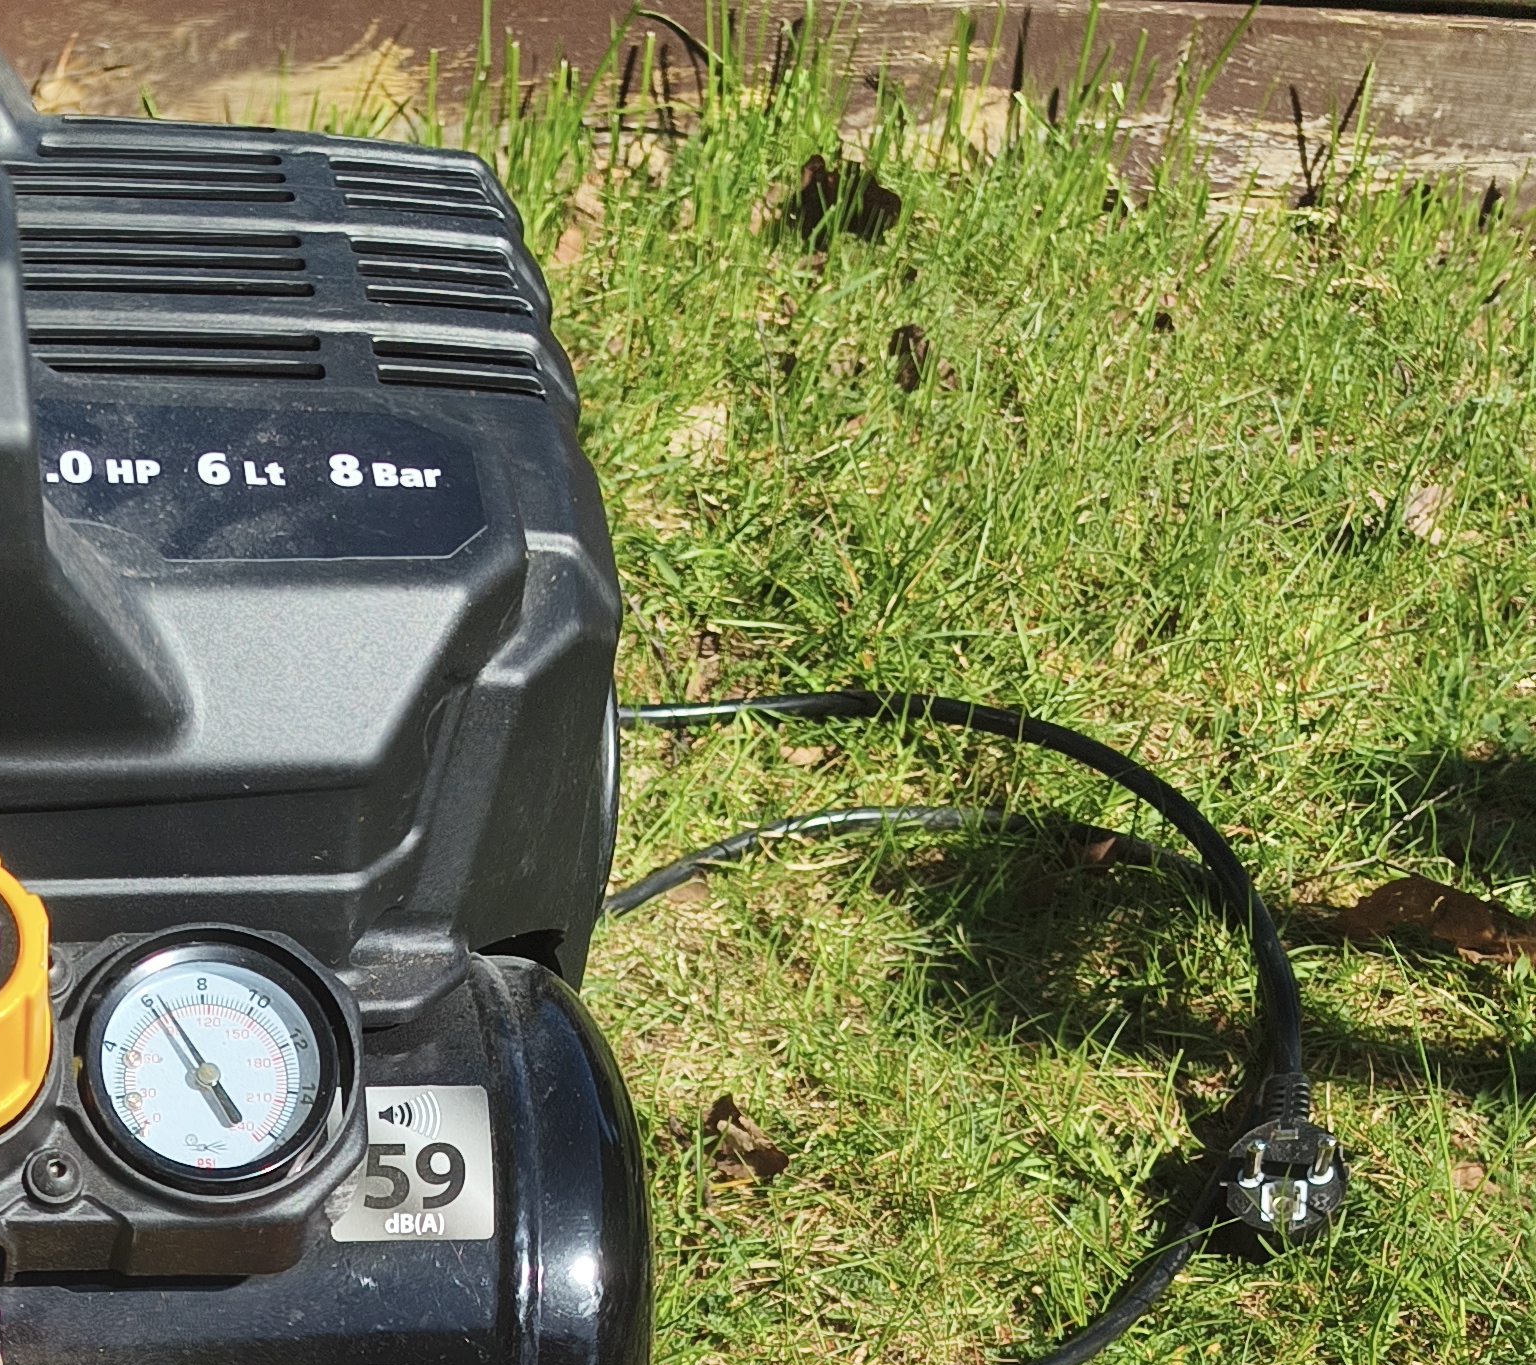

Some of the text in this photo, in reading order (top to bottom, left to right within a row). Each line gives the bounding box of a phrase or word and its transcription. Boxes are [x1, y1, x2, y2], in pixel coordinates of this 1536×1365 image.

[45, 449, 443, 489] .0 HP 6 Lt 8 Bar
[196, 977, 208, 991] 8
[140, 993, 154, 1008] 6
[248, 989, 272, 1009] 10
[196, 1018, 222, 1028] 120
[224, 1029, 250, 1039] 150
[288, 1027, 309, 1054] 12
[102, 1039, 118, 1053] 4
[245, 1058, 272, 1069] 180
[140, 1087, 157, 1098] 30
[245, 1092, 272, 1102] 210
[299, 1082, 316, 1107] 14
[152, 1113, 162, 1123] 0
[196, 1157, 217, 1168] PSI
[363, 1141, 466, 1210] 59
[384, 1212, 445, 1236] dB(A)
